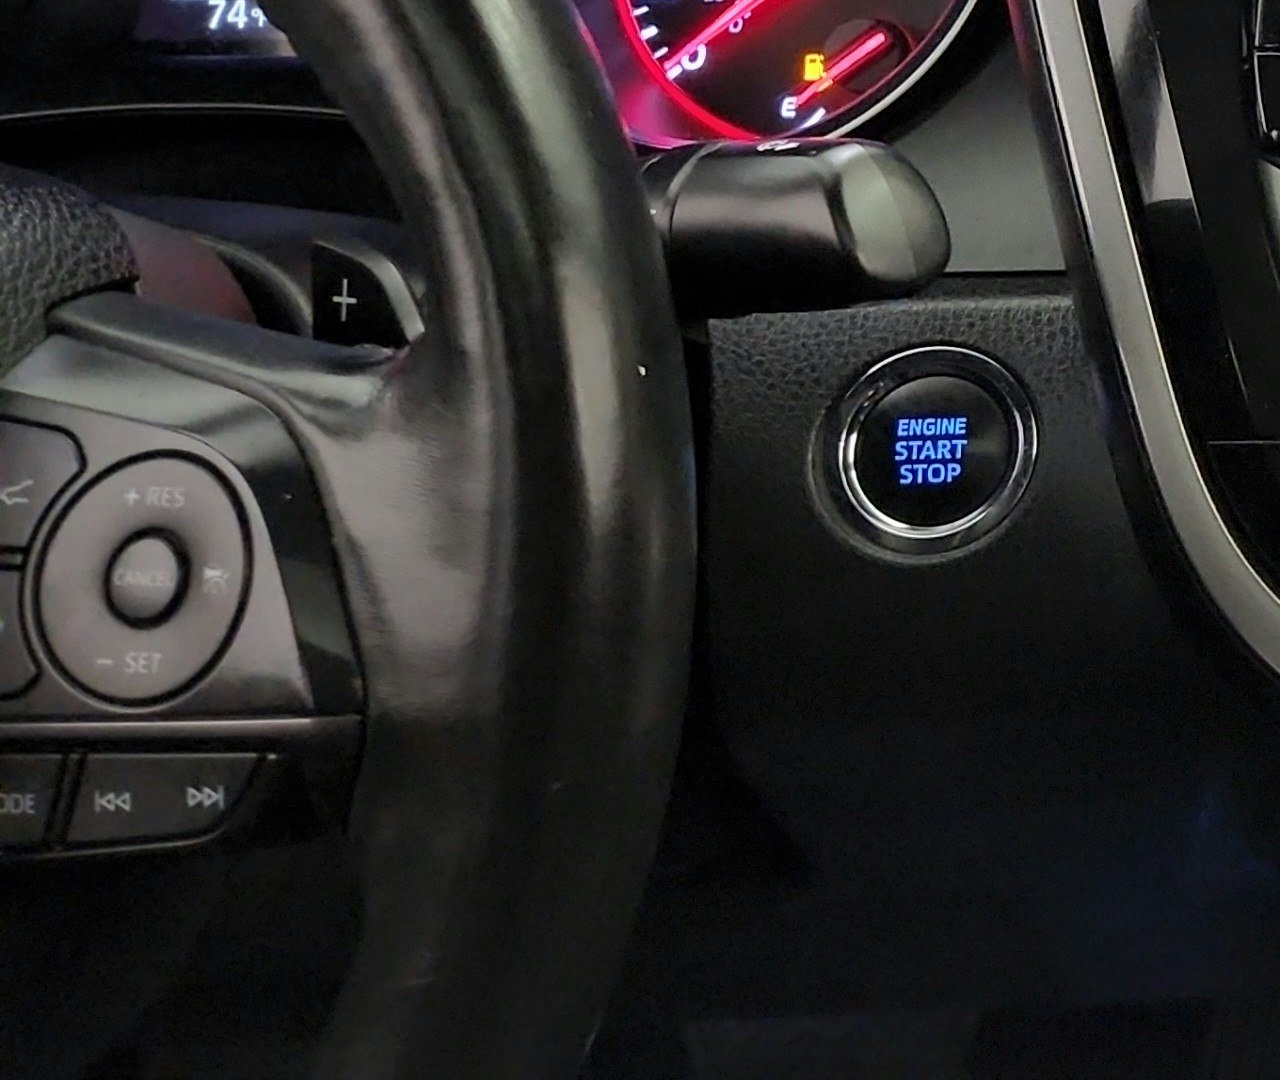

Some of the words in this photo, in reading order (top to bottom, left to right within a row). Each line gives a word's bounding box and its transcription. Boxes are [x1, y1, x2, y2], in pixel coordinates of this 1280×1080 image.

[779, 95, 797, 119] E
[896, 417, 967, 437] ENGINE
[894, 439, 968, 461] START
[899, 462, 962, 485] STOP
[146, 485, 186, 507] RES
[123, 652, 163, 674] SET
[0, 792, 35, 814] ODE
